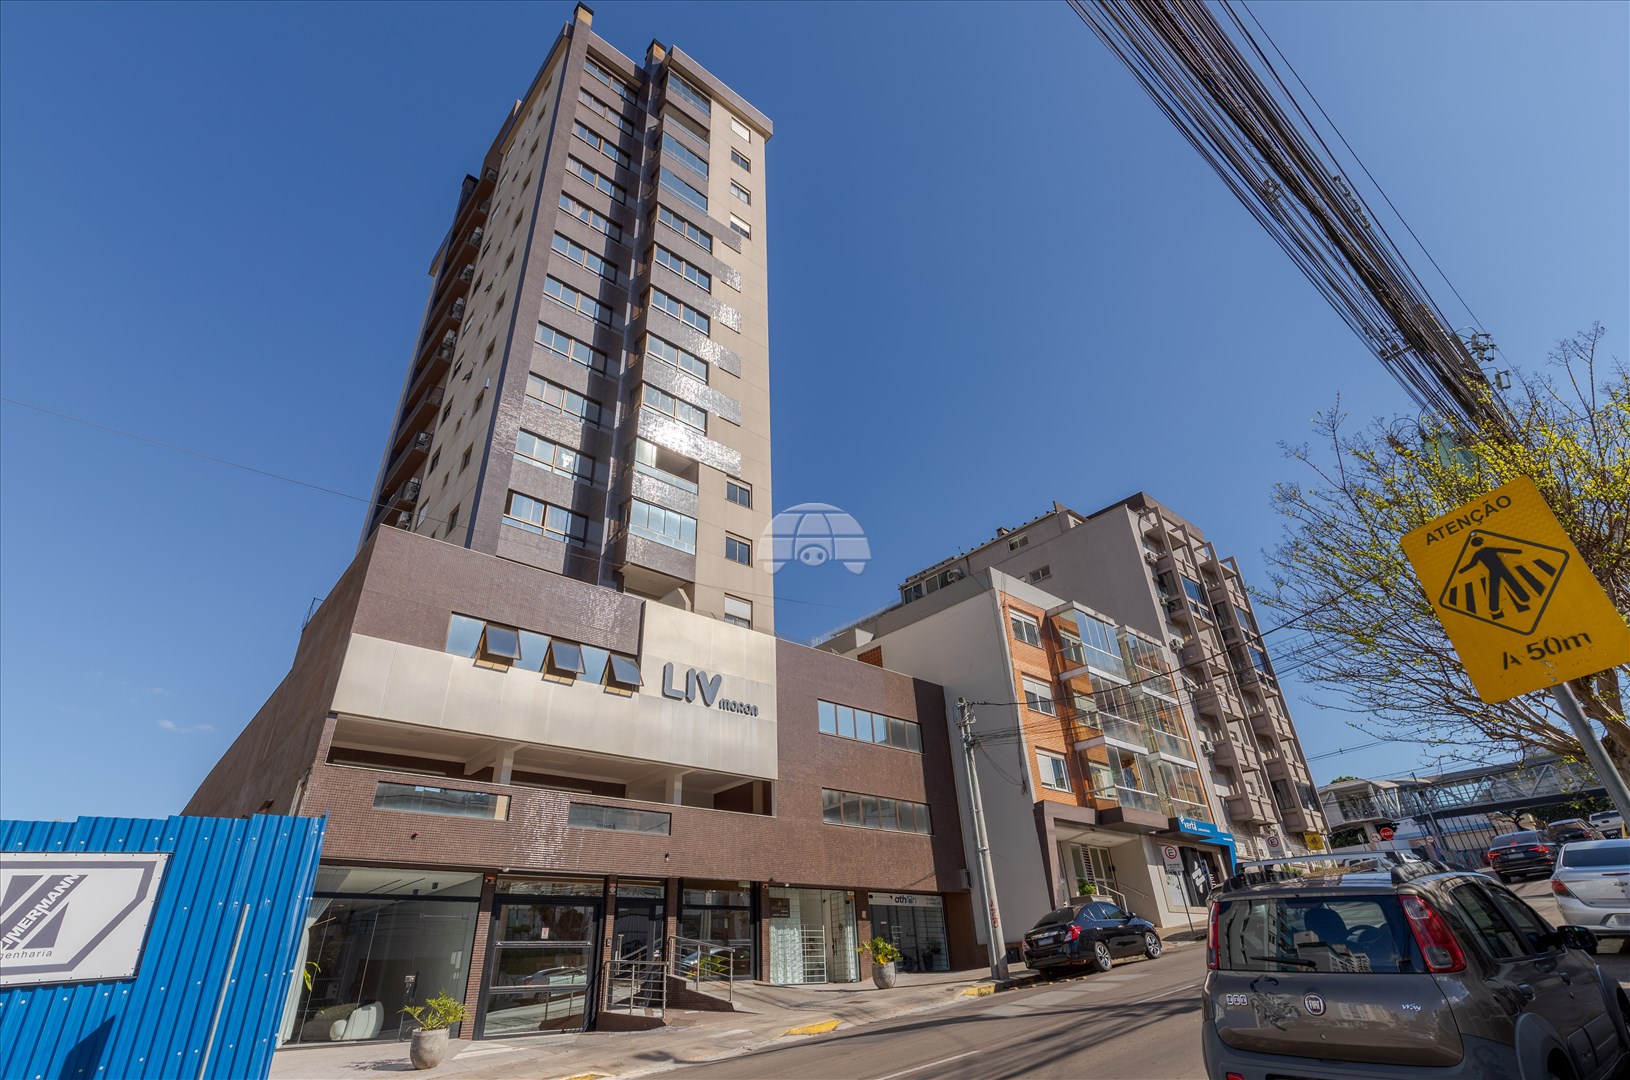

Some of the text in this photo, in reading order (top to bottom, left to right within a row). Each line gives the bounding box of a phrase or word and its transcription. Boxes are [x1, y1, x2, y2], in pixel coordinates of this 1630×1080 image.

[1426, 495, 1512, 546] ATENÇÃO
[1526, 632, 1592, 661] 50m
[662, 662, 722, 707] LIV
